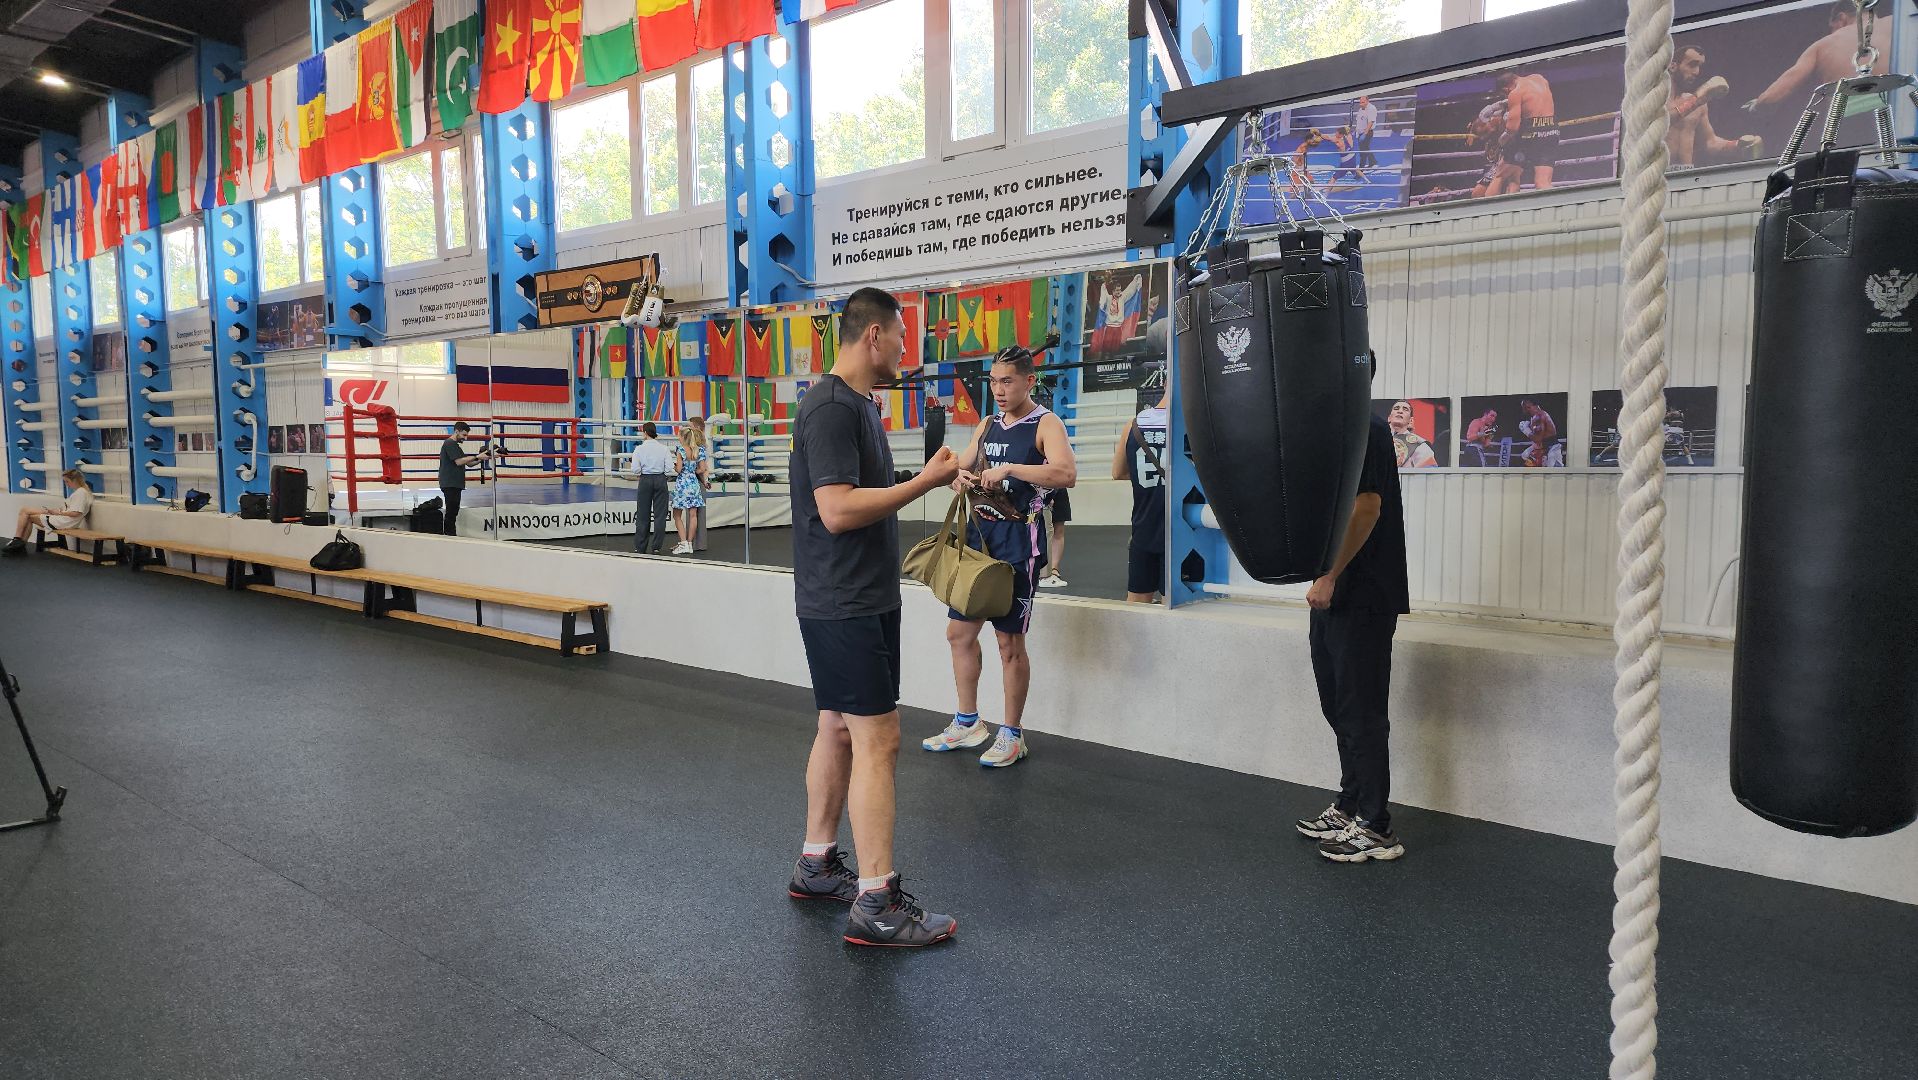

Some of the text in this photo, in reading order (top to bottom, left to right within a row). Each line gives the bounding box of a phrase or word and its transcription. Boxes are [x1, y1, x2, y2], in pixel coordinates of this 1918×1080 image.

[831, 186, 1128, 246] Не сдавайся там, где сдаются другие.
[847, 166, 1103, 223] Тренируйся с теми, кто сильнее.
[832, 211, 1126, 267] И победишь там, где победить нельзя
[417, 282, 454, 296] тренировка
[462, 279, 473, 287] это
[473, 276, 486, 285] шаг
[401, 315, 436, 326] тренировка
[444, 312, 456, 320] это
[468, 308, 486, 317] шага
